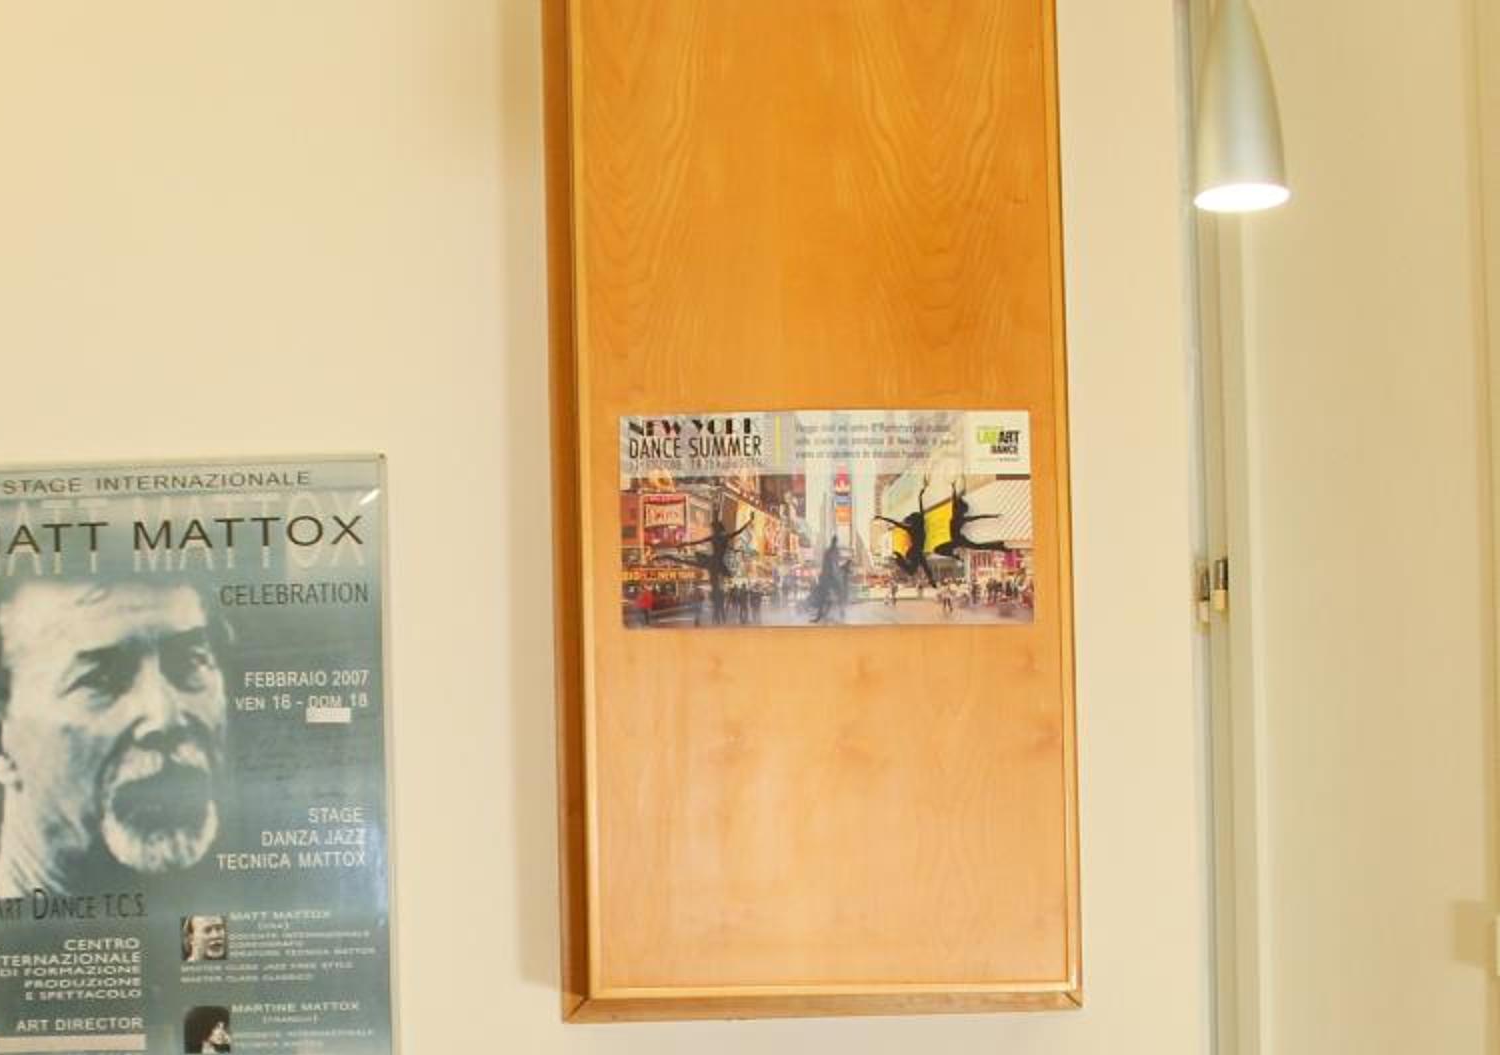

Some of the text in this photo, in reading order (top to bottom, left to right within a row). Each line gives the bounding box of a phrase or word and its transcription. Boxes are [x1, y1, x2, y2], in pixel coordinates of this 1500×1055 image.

[629, 435, 762, 459] DANCE SUMMER
[3, 477, 83, 495] STAGE
[96, 471, 311, 491] INTERNAZIONALE
[133, 515, 365, 551] MATTOX
[220, 581, 369, 605] CELEBRATION
[244, 669, 371, 688] FEBBRAIO 2007
[235, 695, 266, 711] VEN
[272, 693, 292, 710] 16
[307, 807, 365, 824] STAGE
[260, 828, 366, 847] DANZA JAZZ
[216, 850, 366, 870] TECNICA MATTOX
[63, 937, 141, 952] CENTRO
[0, 964, 142, 977] DI FORMAZIONE
[23, 977, 142, 989] PRODUZIONE
[39, 989, 142, 1000] SPETTACOLO
[15, 1017, 144, 1032] ART DIRECTOR
